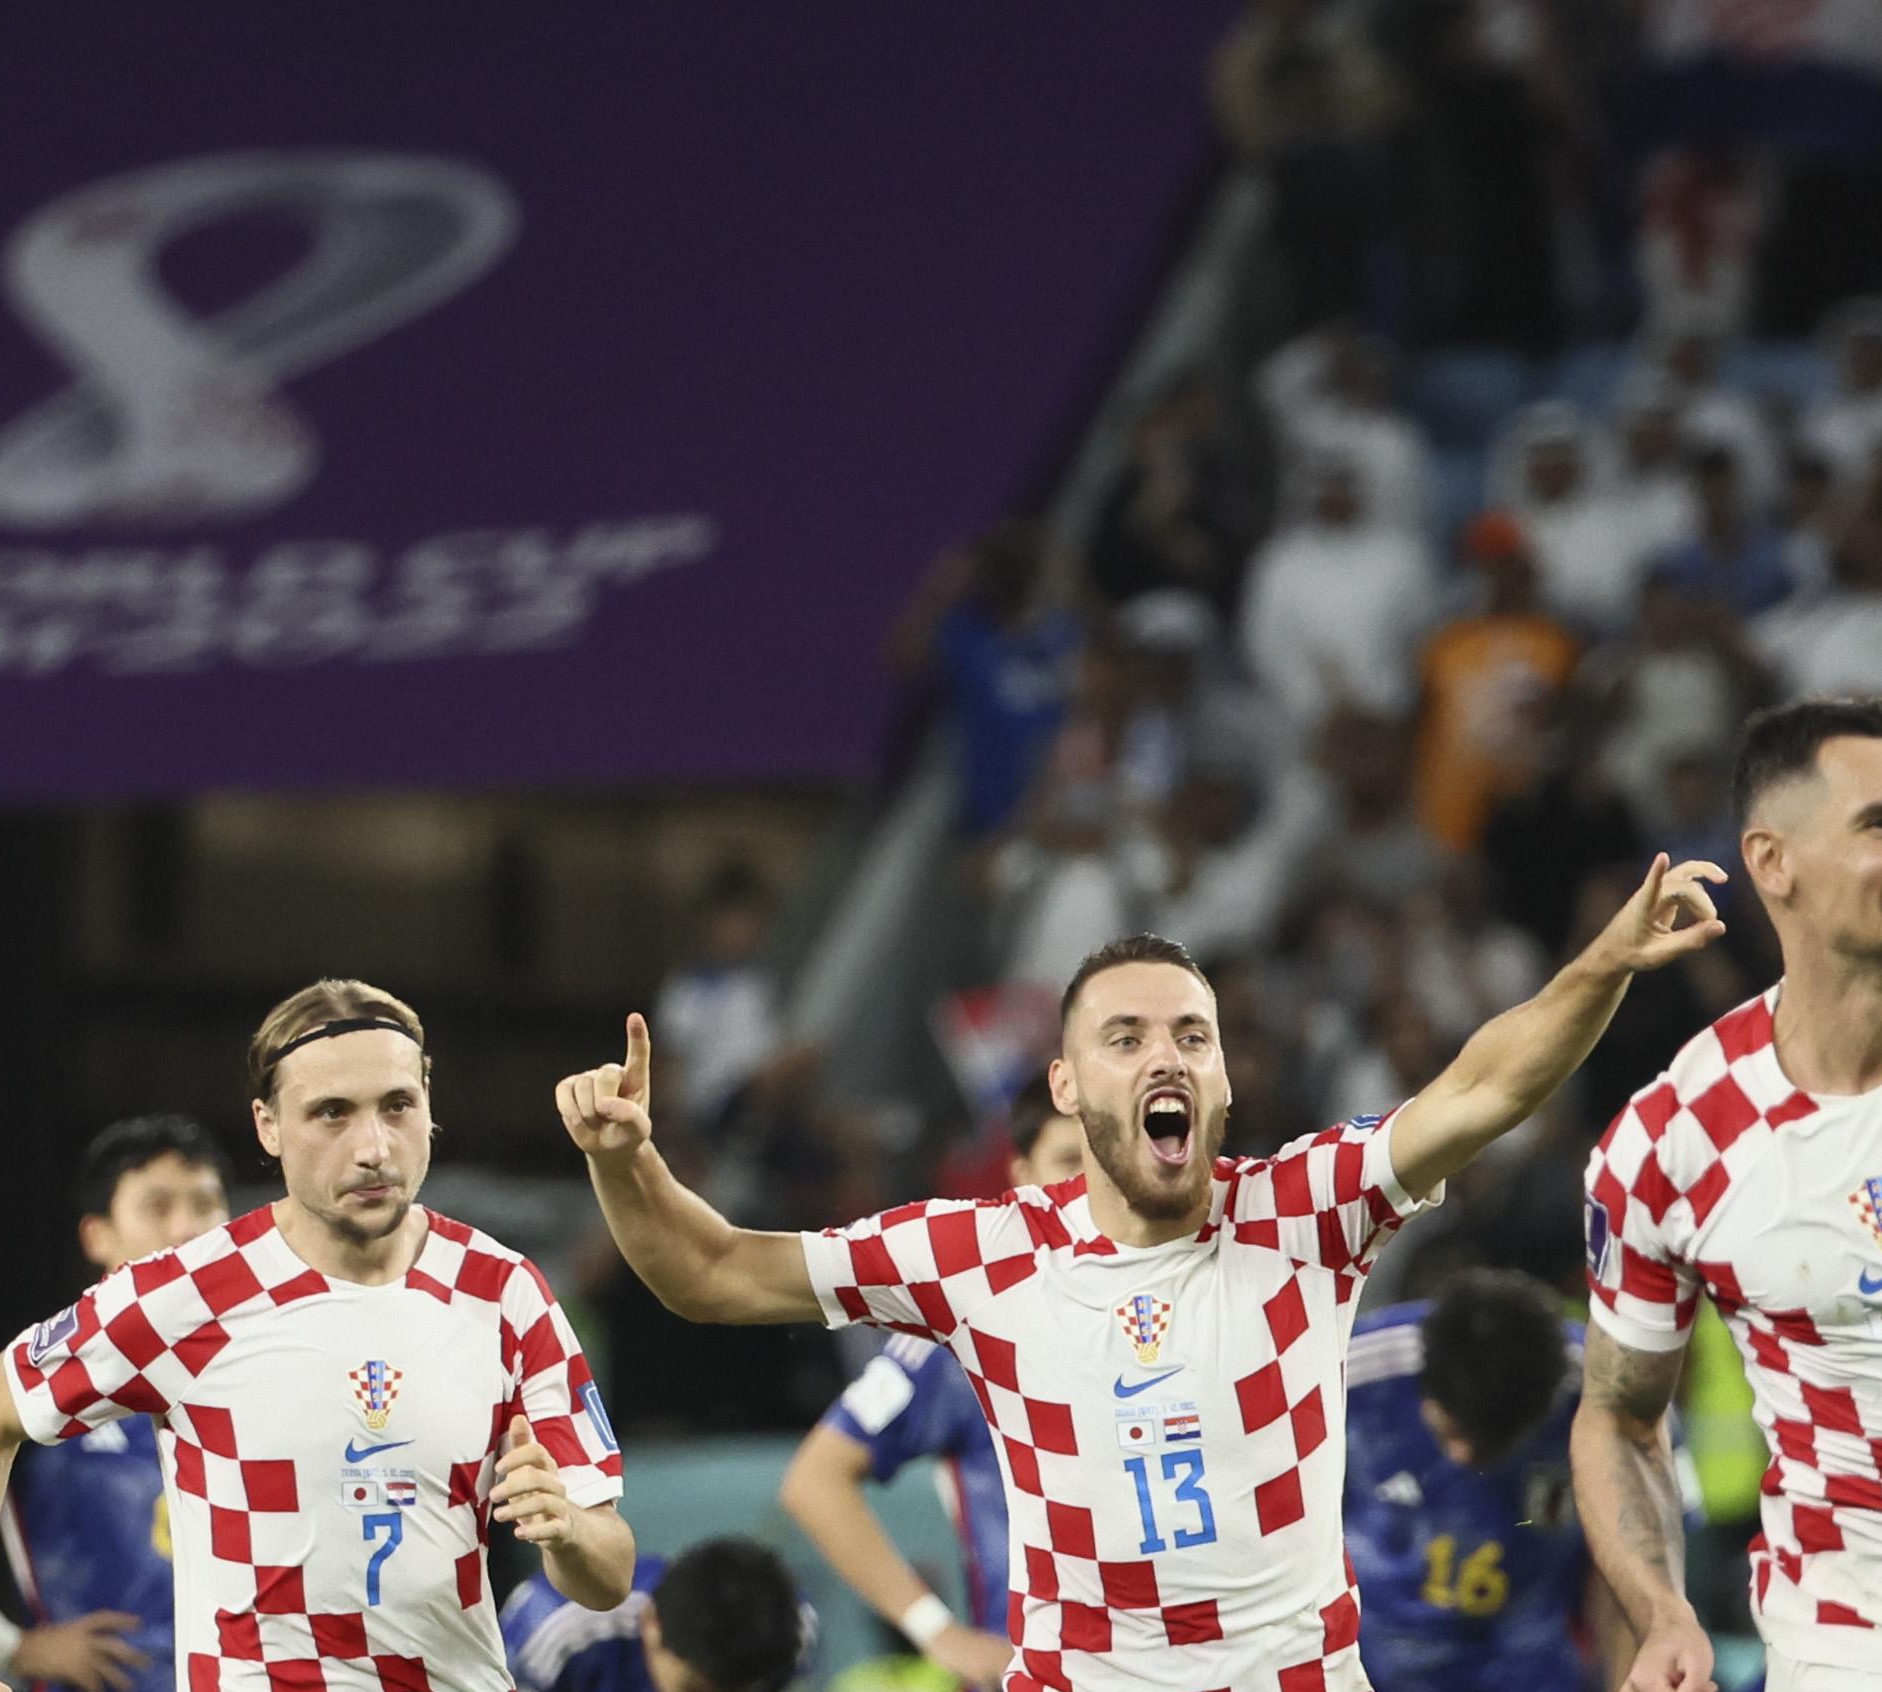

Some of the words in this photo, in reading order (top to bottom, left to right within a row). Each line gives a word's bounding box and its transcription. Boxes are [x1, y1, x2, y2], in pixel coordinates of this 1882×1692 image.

[1123, 1447, 1218, 1555] 13
[362, 1511, 404, 1607] 7
[1420, 1534, 1509, 1617] 16
